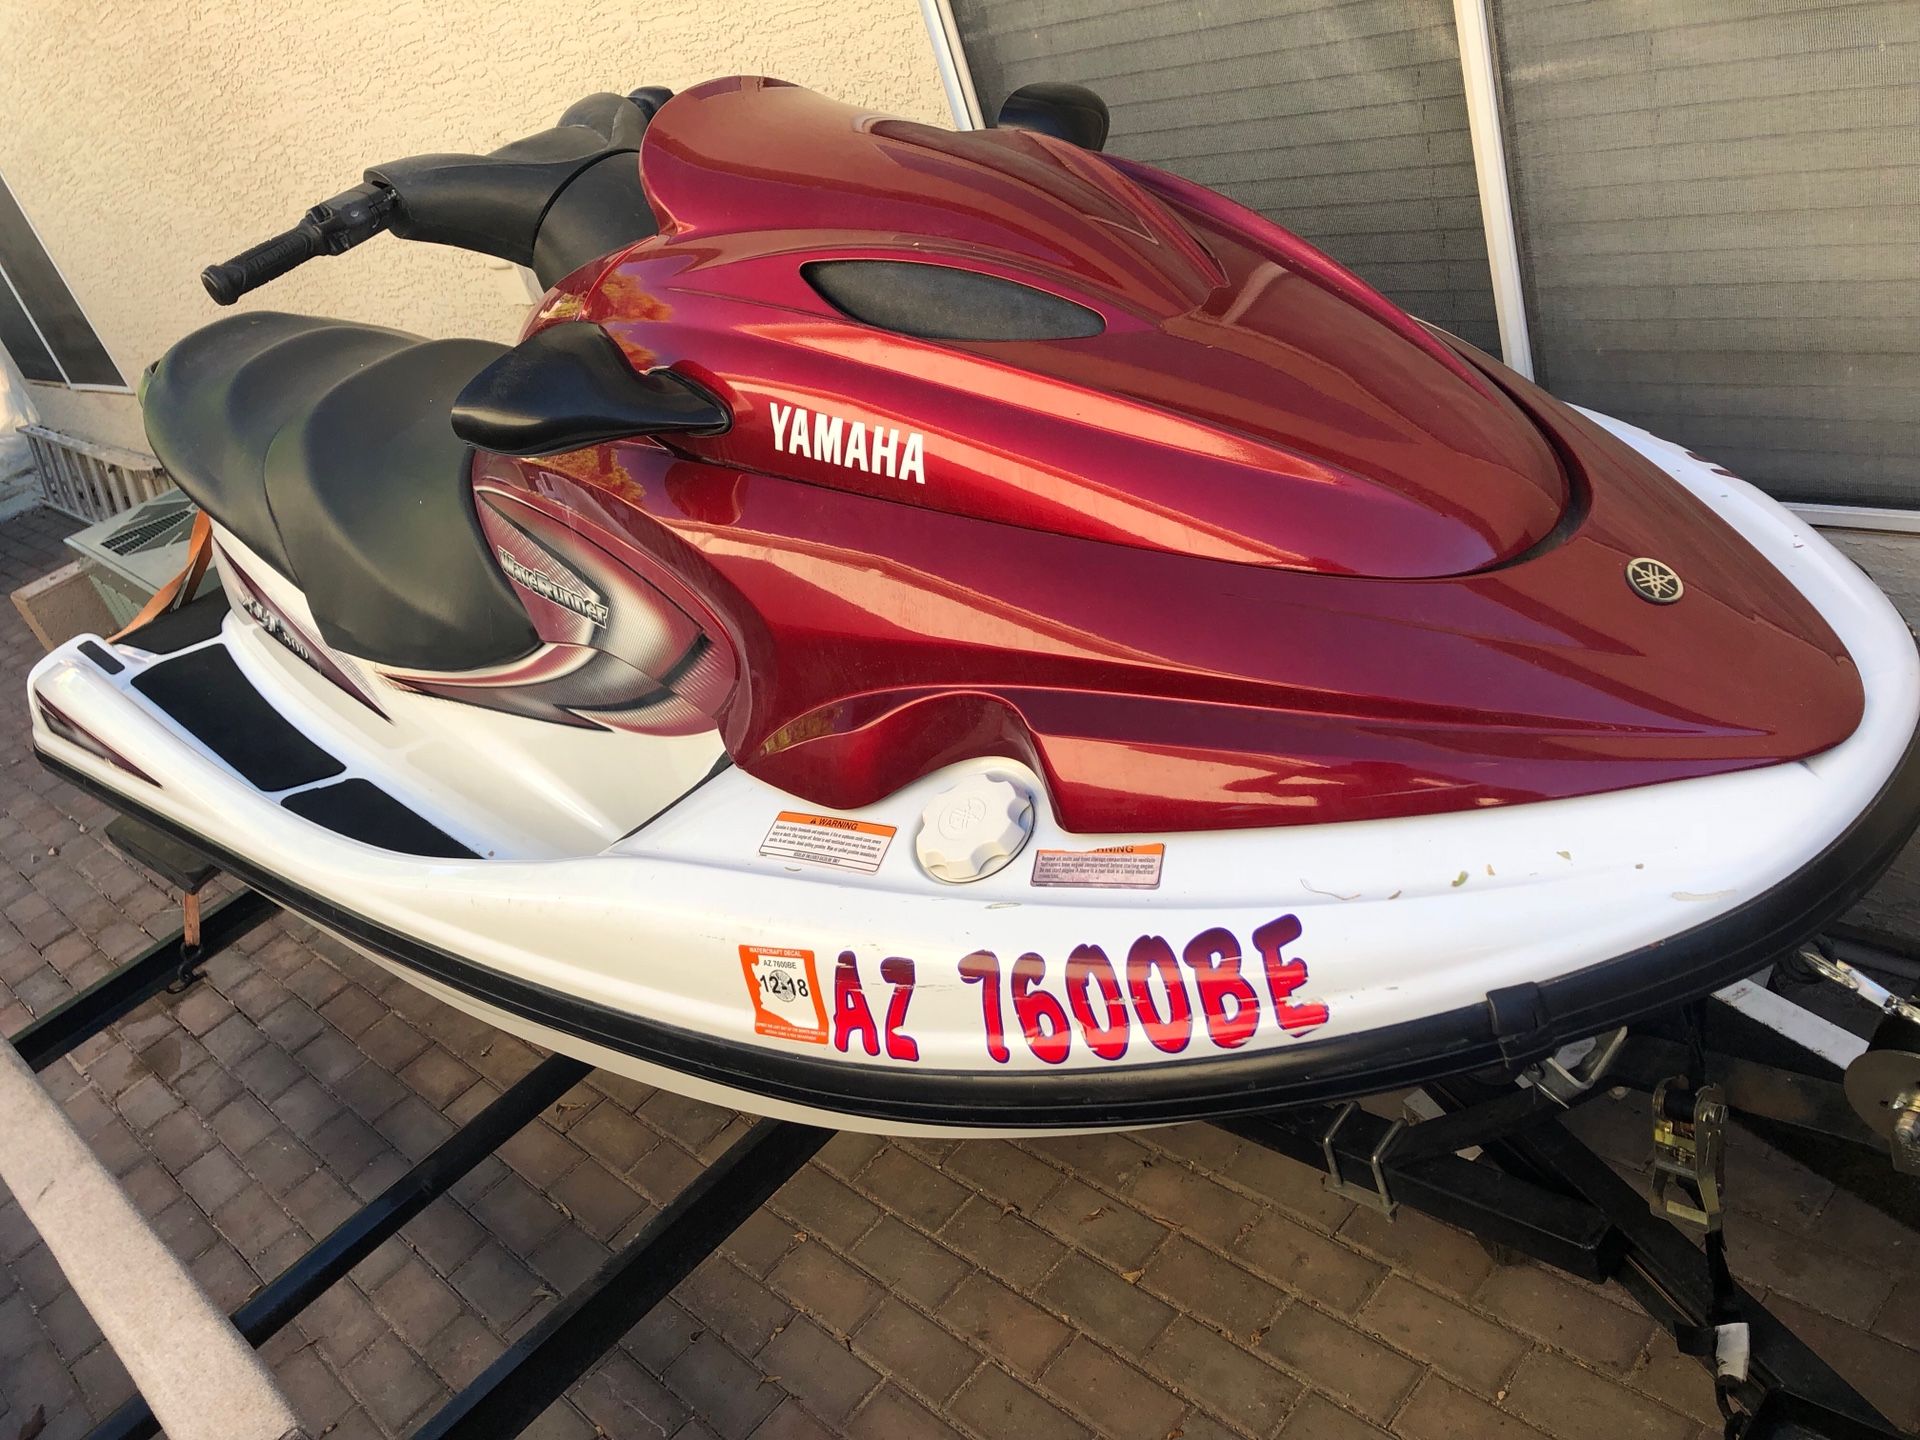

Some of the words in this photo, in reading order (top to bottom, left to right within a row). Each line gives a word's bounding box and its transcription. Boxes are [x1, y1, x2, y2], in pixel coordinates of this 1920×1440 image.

[769, 402, 926, 485] YAMAHA
[498, 545, 609, 629] WaveRunner
[818, 818, 859, 831] WARNING
[773, 960, 797, 969] 7600BE
[783, 949, 801, 957] DECAL
[760, 974, 808, 997] 12-18
[833, 950, 920, 1063] AZ
[957, 913, 1330, 1065] 7600BE
